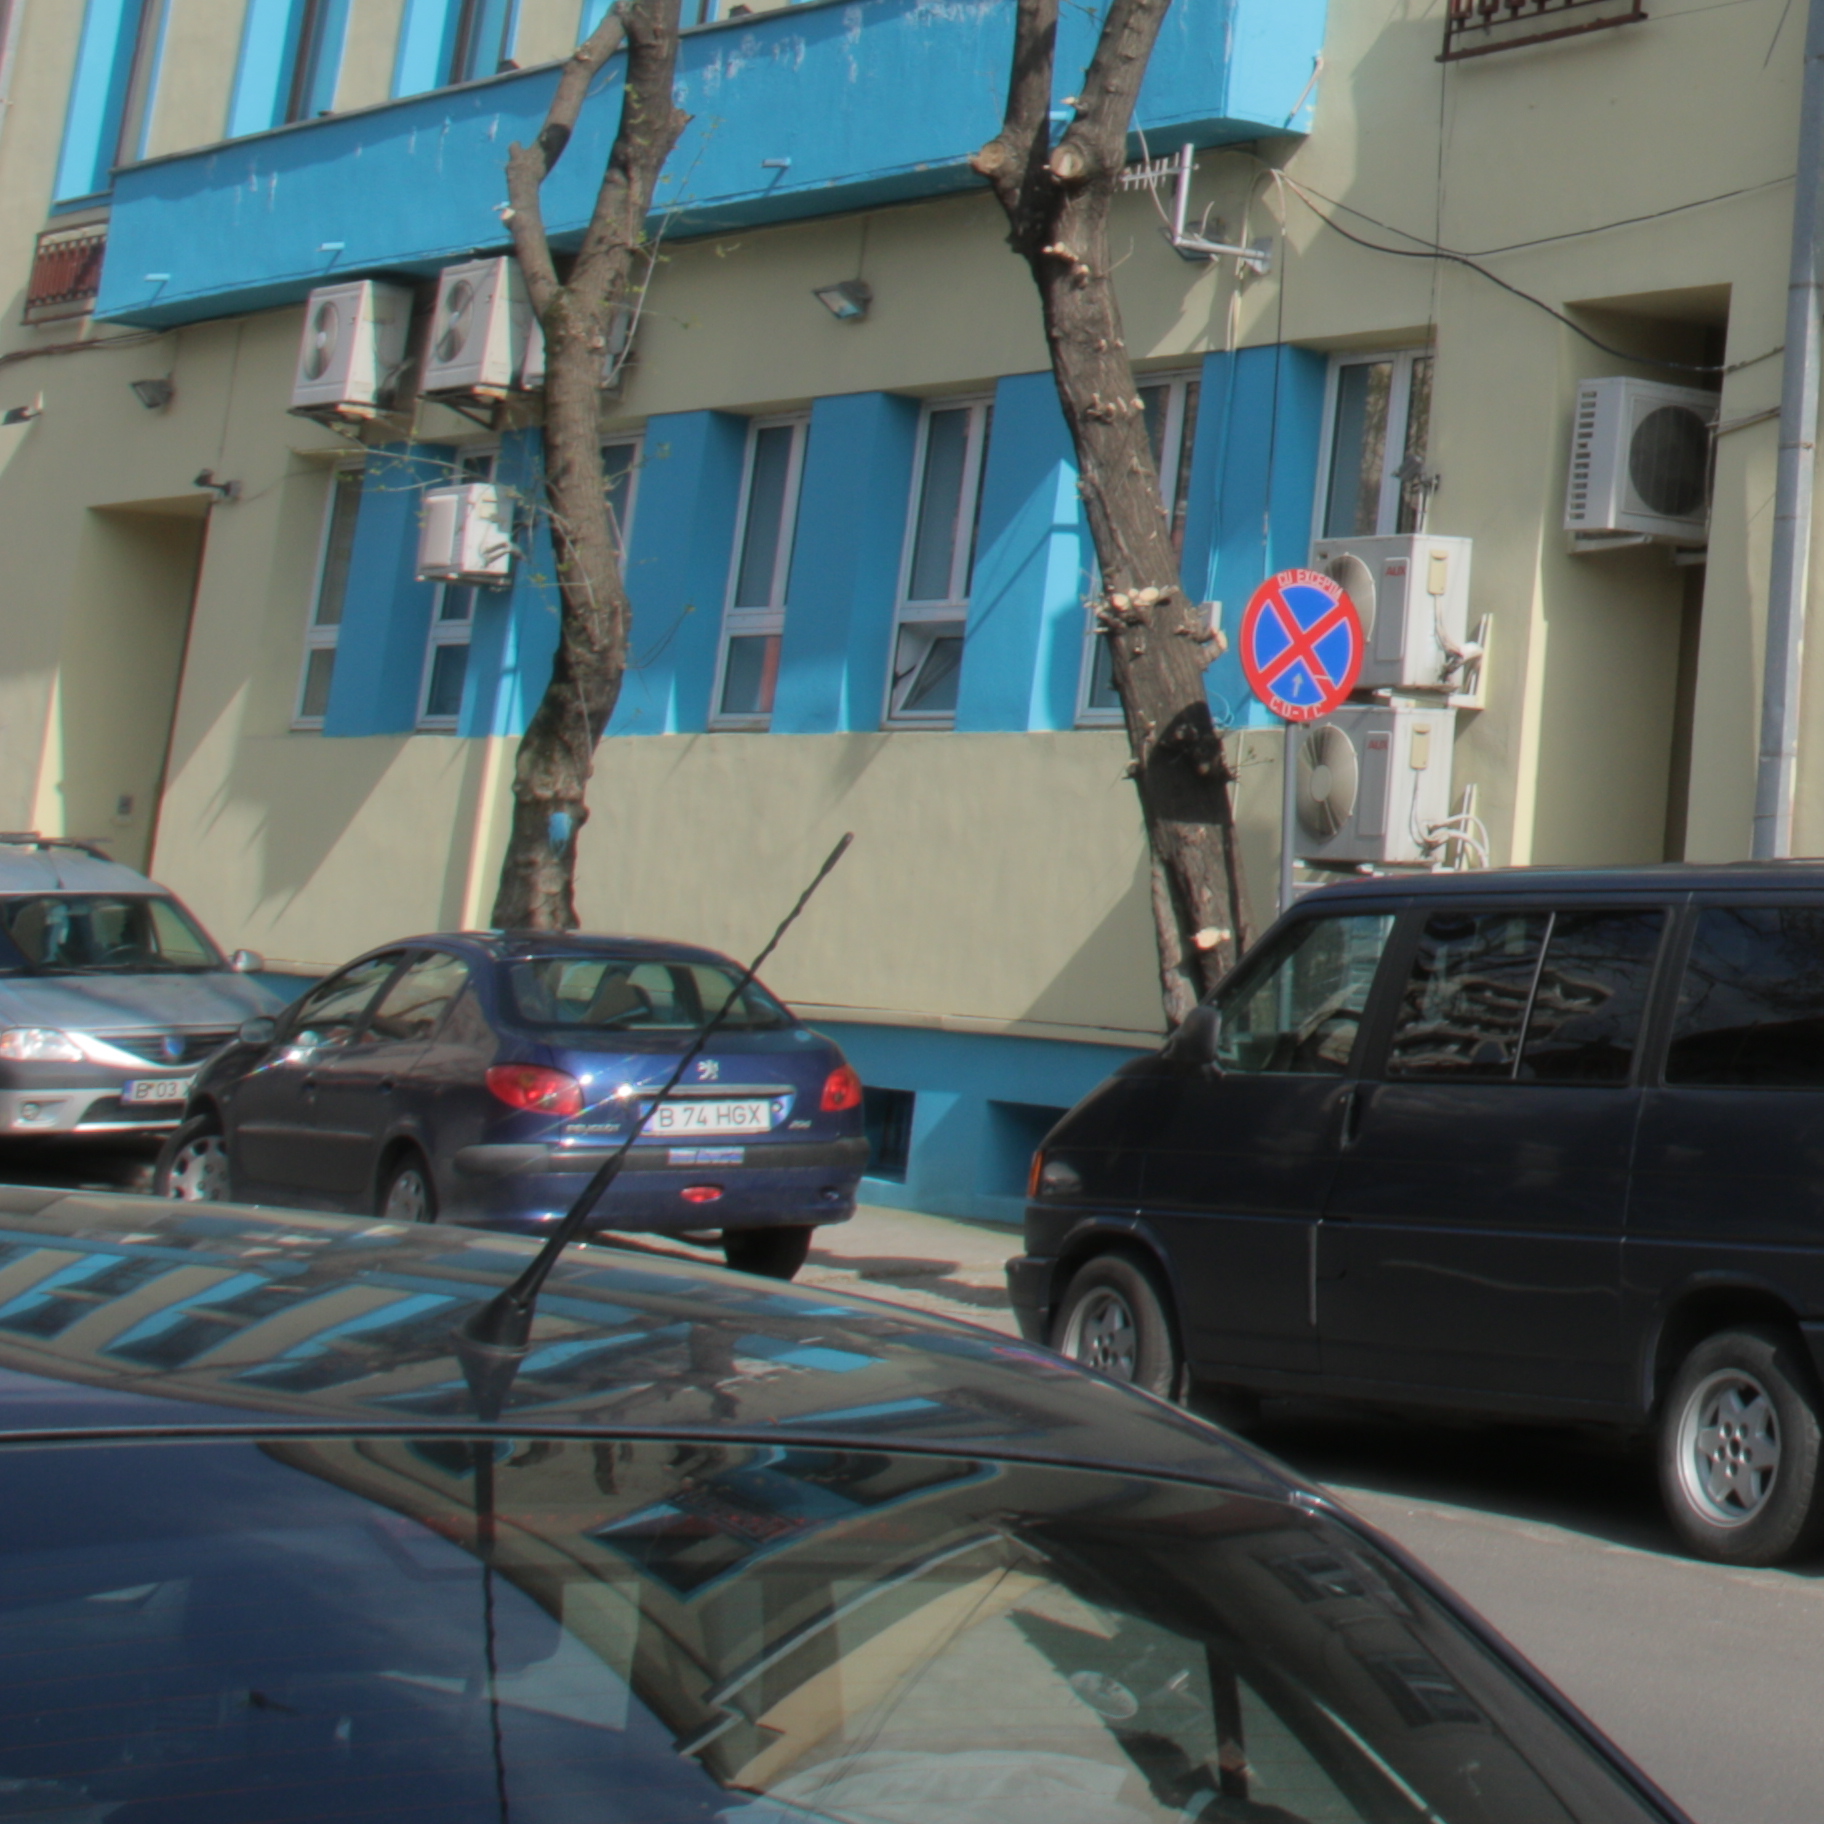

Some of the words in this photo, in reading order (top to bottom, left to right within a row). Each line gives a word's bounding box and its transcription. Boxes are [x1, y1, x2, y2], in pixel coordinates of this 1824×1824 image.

[1277, 571, 1293, 588] CU
[659, 1107, 675, 1128] B
[683, 1106, 708, 1126] 74
[716, 1104, 762, 1125] HGX
